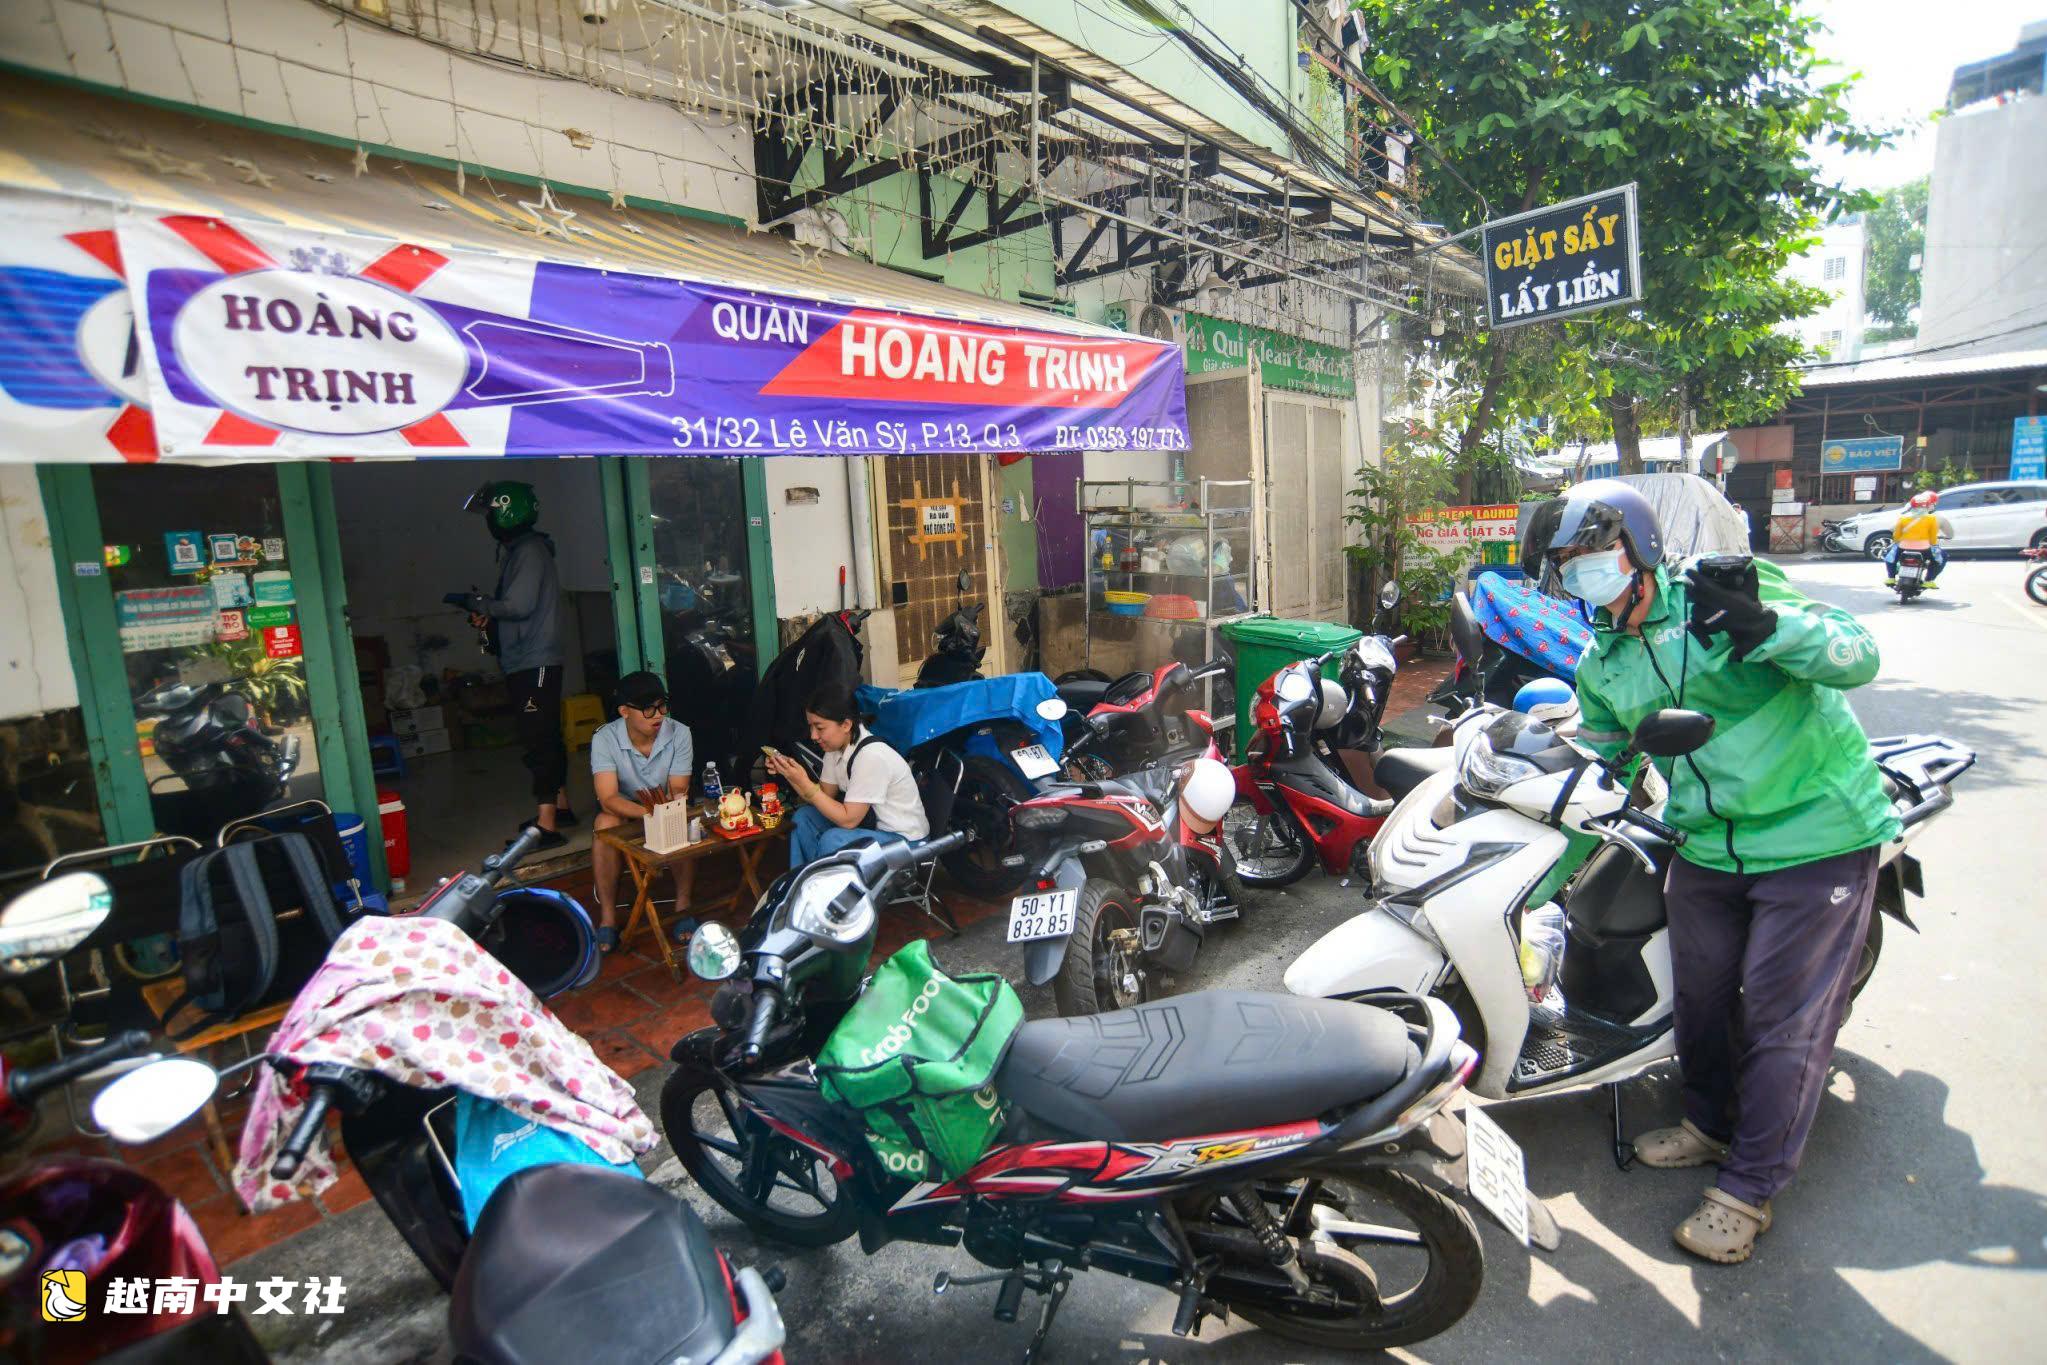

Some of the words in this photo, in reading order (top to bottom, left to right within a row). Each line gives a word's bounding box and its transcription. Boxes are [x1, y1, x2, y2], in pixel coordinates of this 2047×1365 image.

[1494, 226, 1558, 271] GIẶT
[1563, 205, 1619, 256] SẤY
[1499, 275, 1552, 319] LẤY
[1556, 260, 1621, 307] LIỀN
[221, 292, 418, 343] HOÀNG
[245, 364, 418, 412] TRỊNH
[1023, 344, 1128, 403] TRỊNH
[671, 416, 763, 448] 31/32
[769, 418, 808, 448] Lê
[812, 419, 869, 448] Văn
[875, 420, 918, 455] Sỹ,
[921, 421, 978, 451] P.13,
[1055, 425, 1085, 448] ĐT:
[1086, 426, 1128, 448] 0353
[1013, 913, 1068, 940] 832.85
[1020, 893, 1065, 917] 50-Y1
